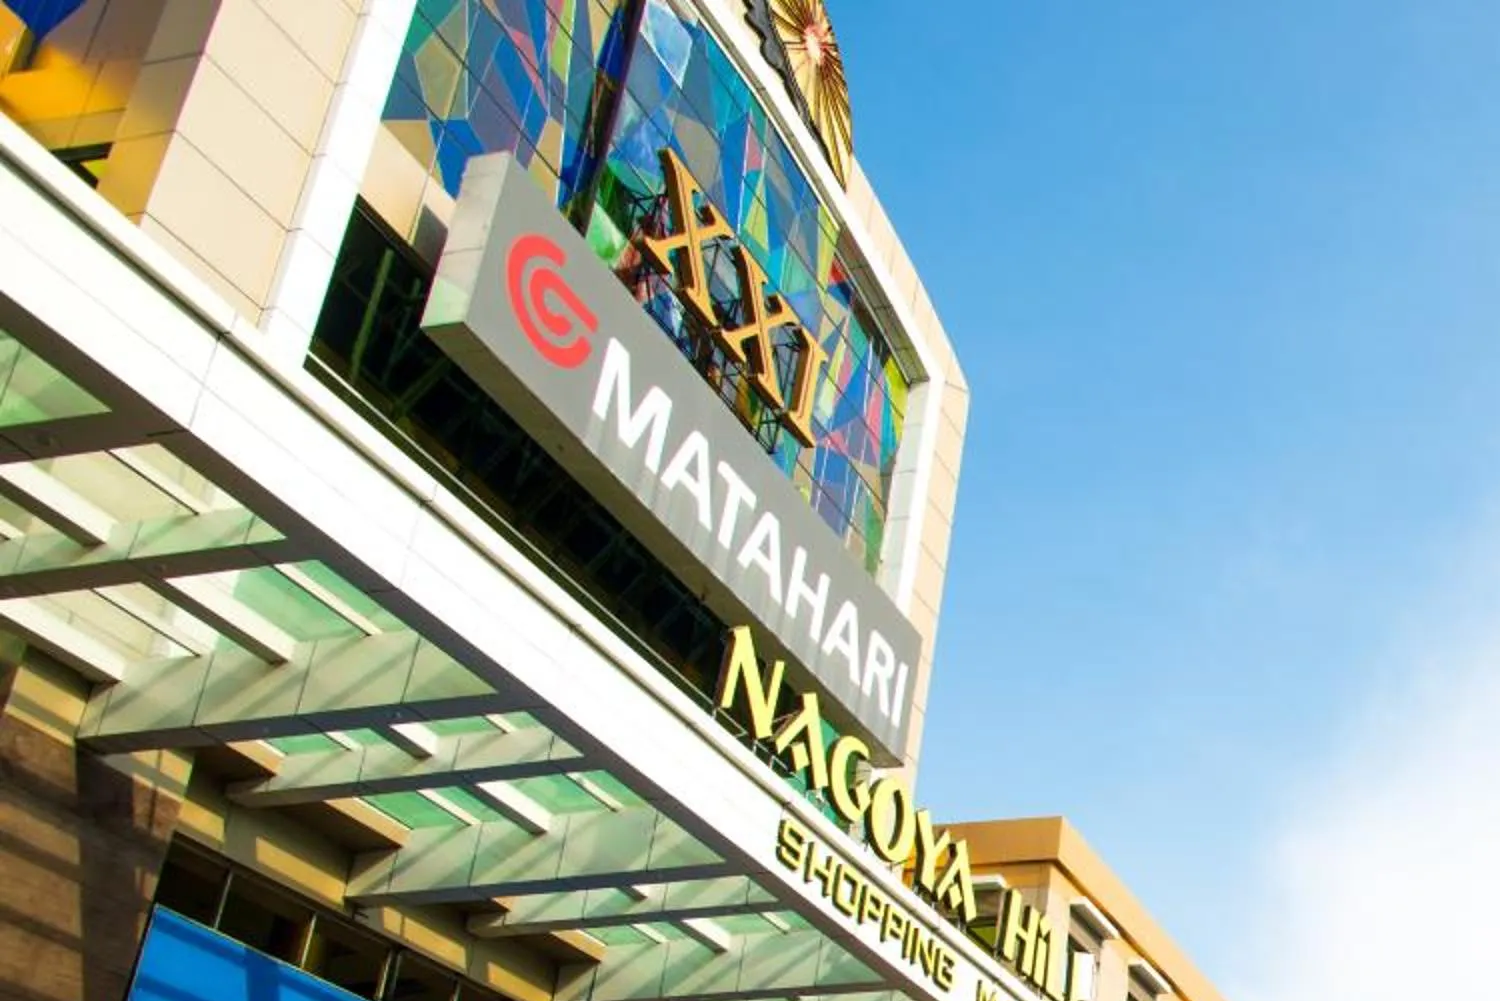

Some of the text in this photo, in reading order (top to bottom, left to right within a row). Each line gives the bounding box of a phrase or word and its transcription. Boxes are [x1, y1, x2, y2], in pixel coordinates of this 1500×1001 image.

[640, 147, 829, 447] XXI
[592, 337, 909, 728] MATAHARI
[718, 624, 977, 923] NAGOYA
[776, 818, 955, 992] SHOPPING
